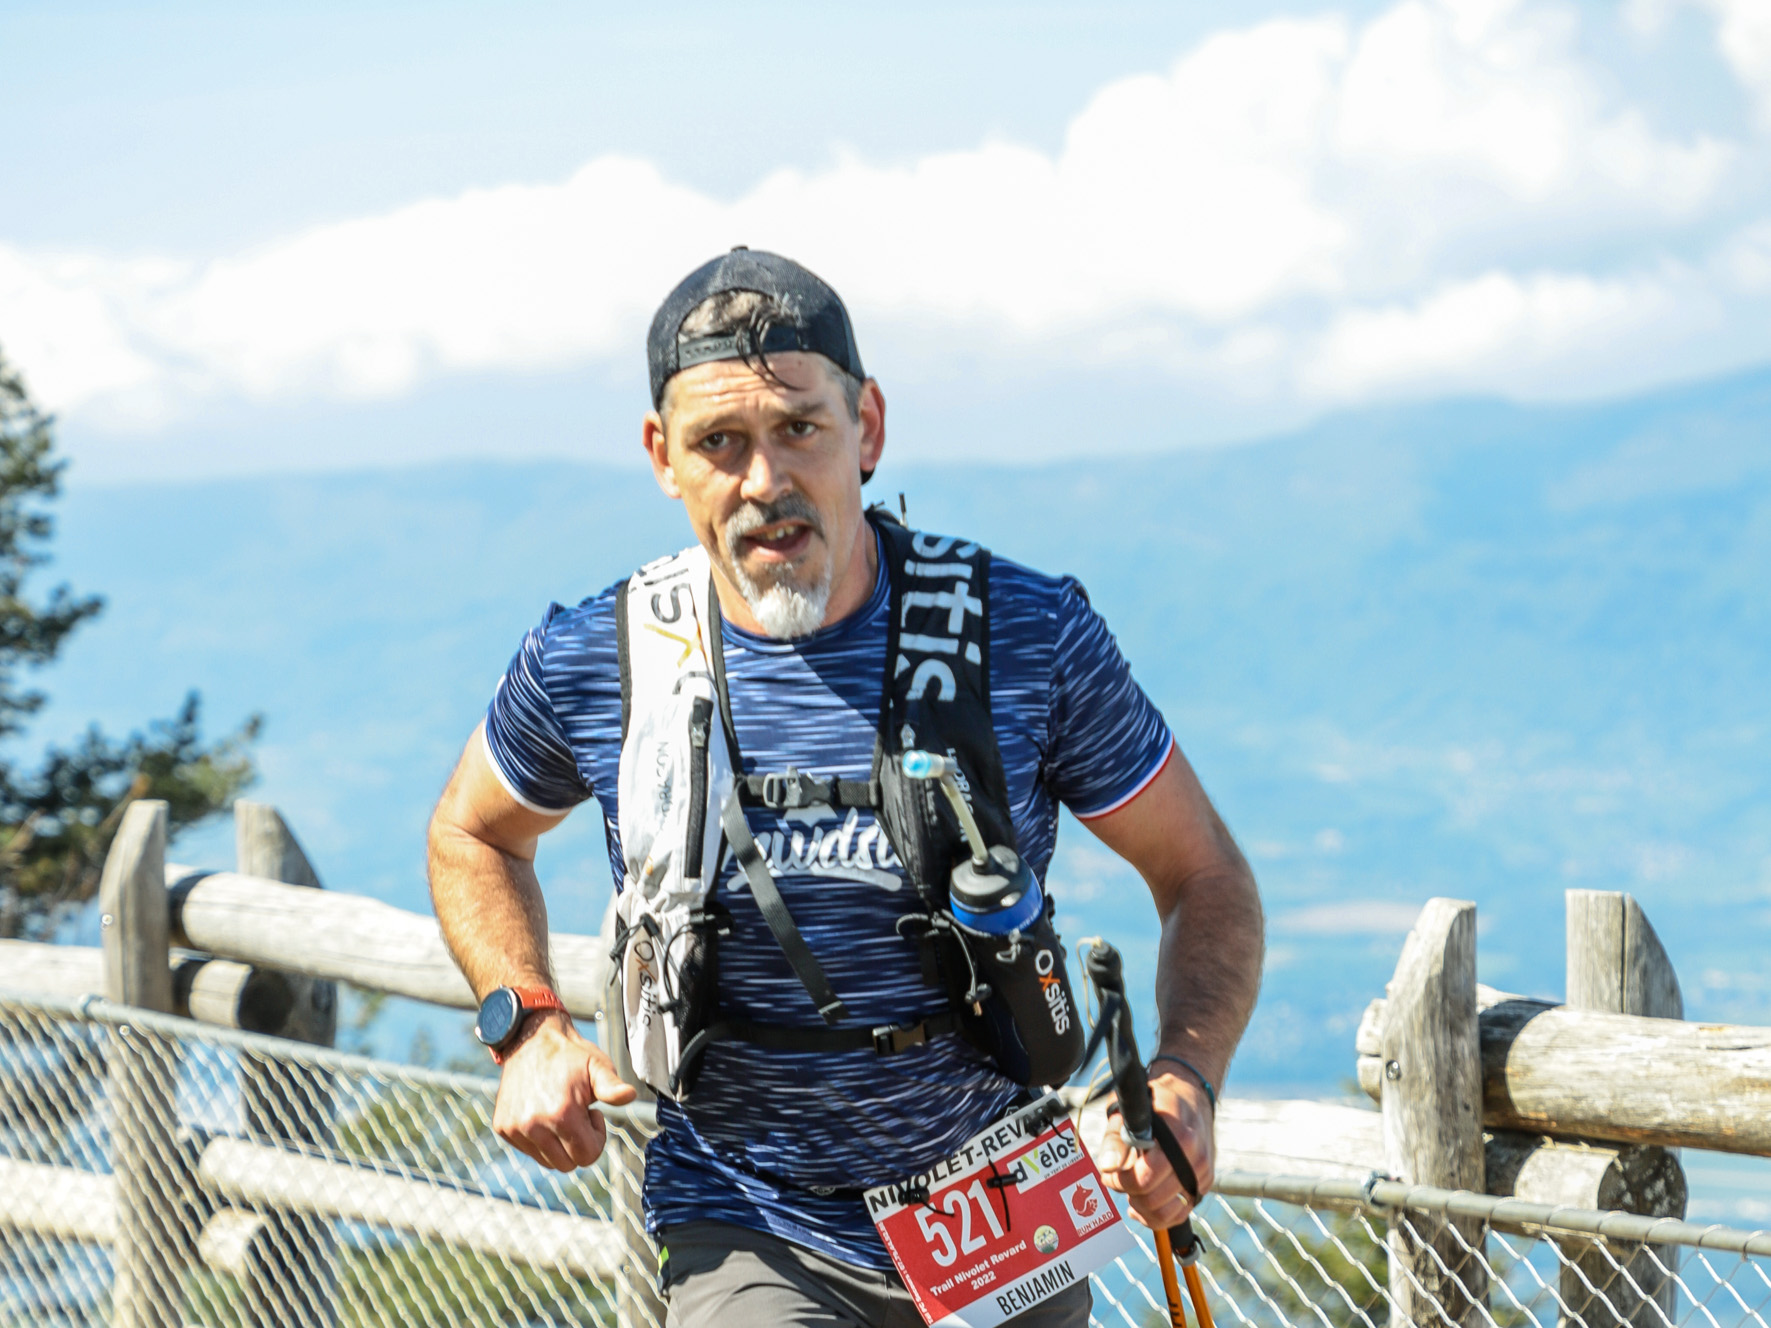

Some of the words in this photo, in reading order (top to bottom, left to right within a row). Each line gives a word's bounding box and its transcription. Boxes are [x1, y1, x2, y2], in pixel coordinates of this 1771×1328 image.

[1035, 949, 1070, 1035] Oxsitis
[914, 1179, 1005, 1267] 521
[930, 1279, 955, 1297] Trail
[954, 1259, 990, 1285] Nivolet
[990, 1240, 1027, 1265] Revard
[971, 1270, 997, 1291] 2022
[996, 1260, 1075, 1317] BENJAMIN
